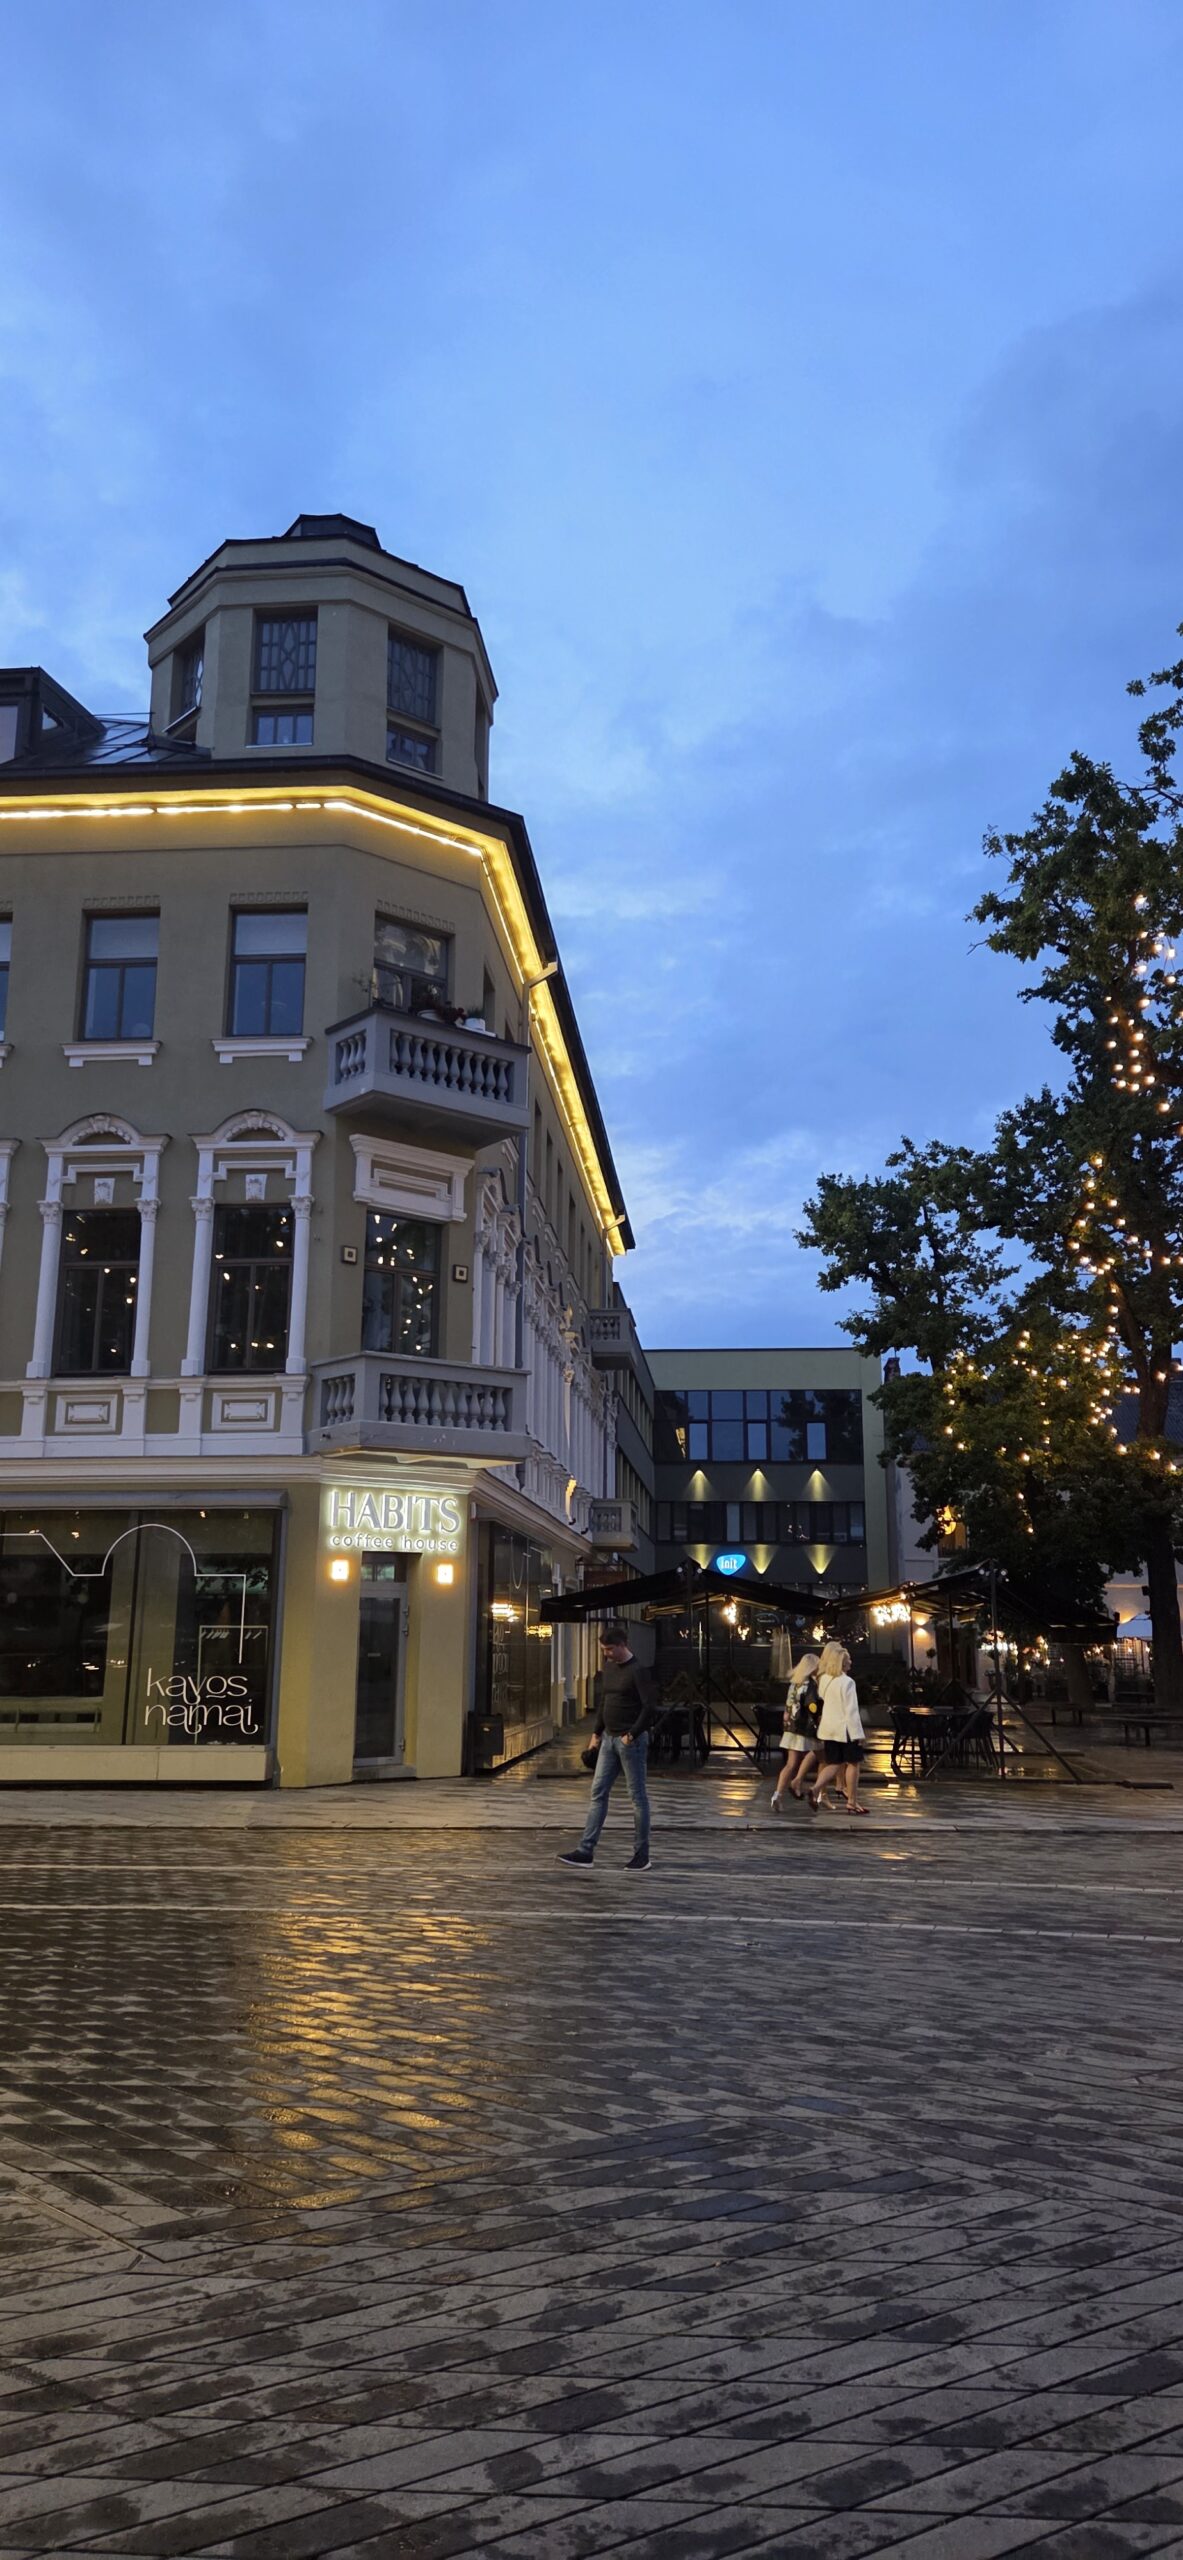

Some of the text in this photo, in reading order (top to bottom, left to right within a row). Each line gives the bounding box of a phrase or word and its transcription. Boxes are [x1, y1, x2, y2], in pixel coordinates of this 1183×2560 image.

[330, 1490, 461, 1533] HABITS
[331, 1533, 458, 1551] coffee house
[144, 1698, 259, 1735] namai
